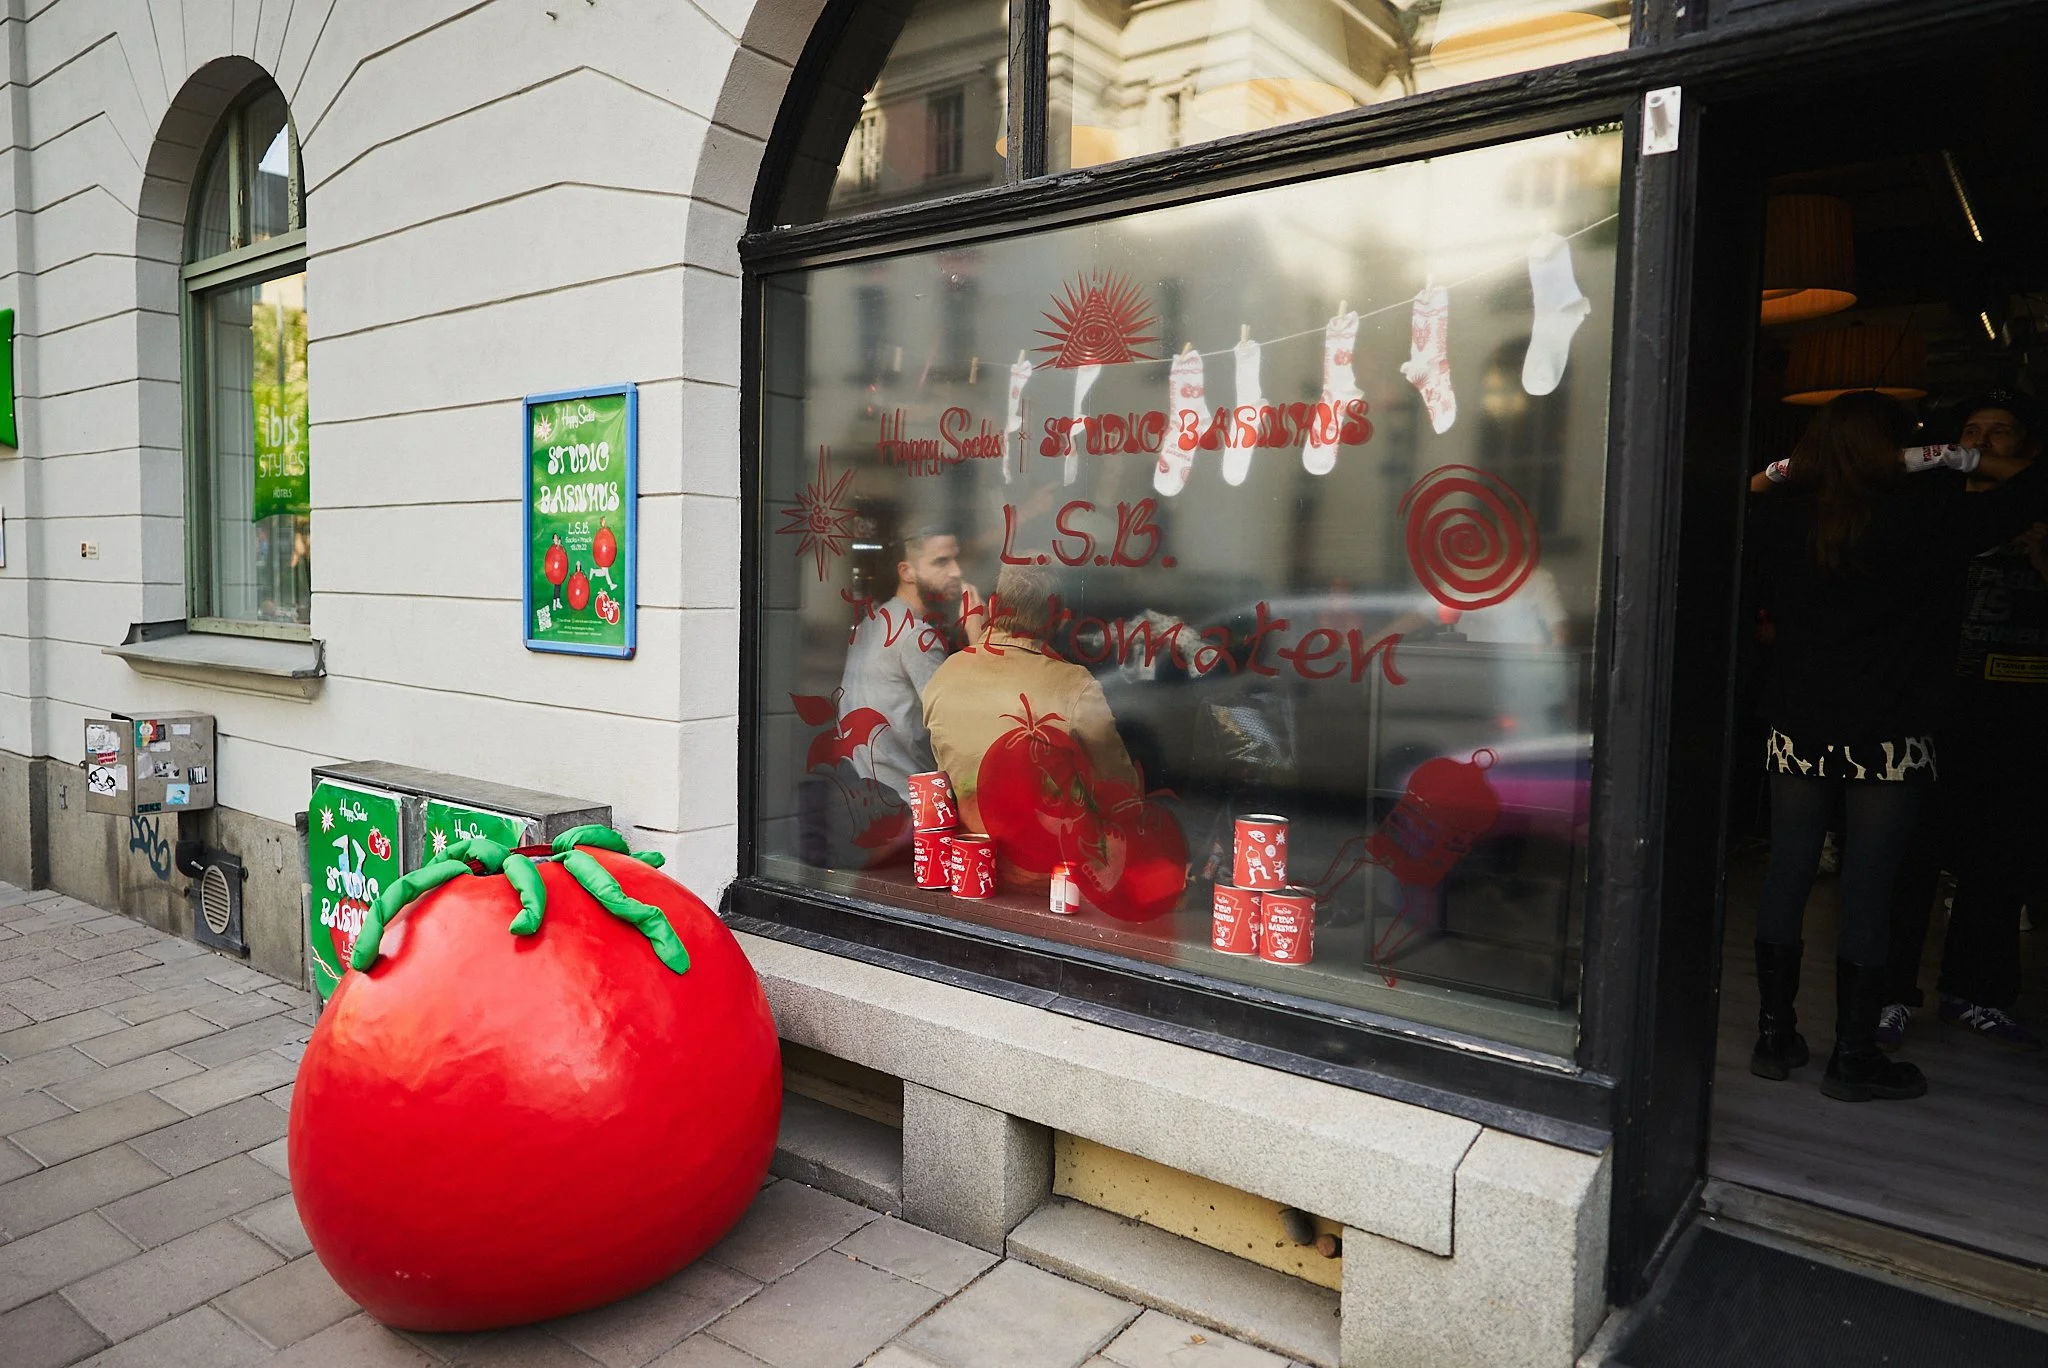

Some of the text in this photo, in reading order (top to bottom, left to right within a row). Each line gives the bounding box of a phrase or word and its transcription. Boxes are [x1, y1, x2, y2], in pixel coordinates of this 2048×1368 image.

[264, 404, 299, 448] ibis
[876, 406, 1005, 477] Happy Socks
[1040, 399, 1372, 457] STUDIO BARNHUS
[547, 441, 609, 475] STUDIO
[999, 498, 1177, 568] L.S.B.
[326, 866, 379, 903] STUDIO
[320, 897, 369, 937] BARN
